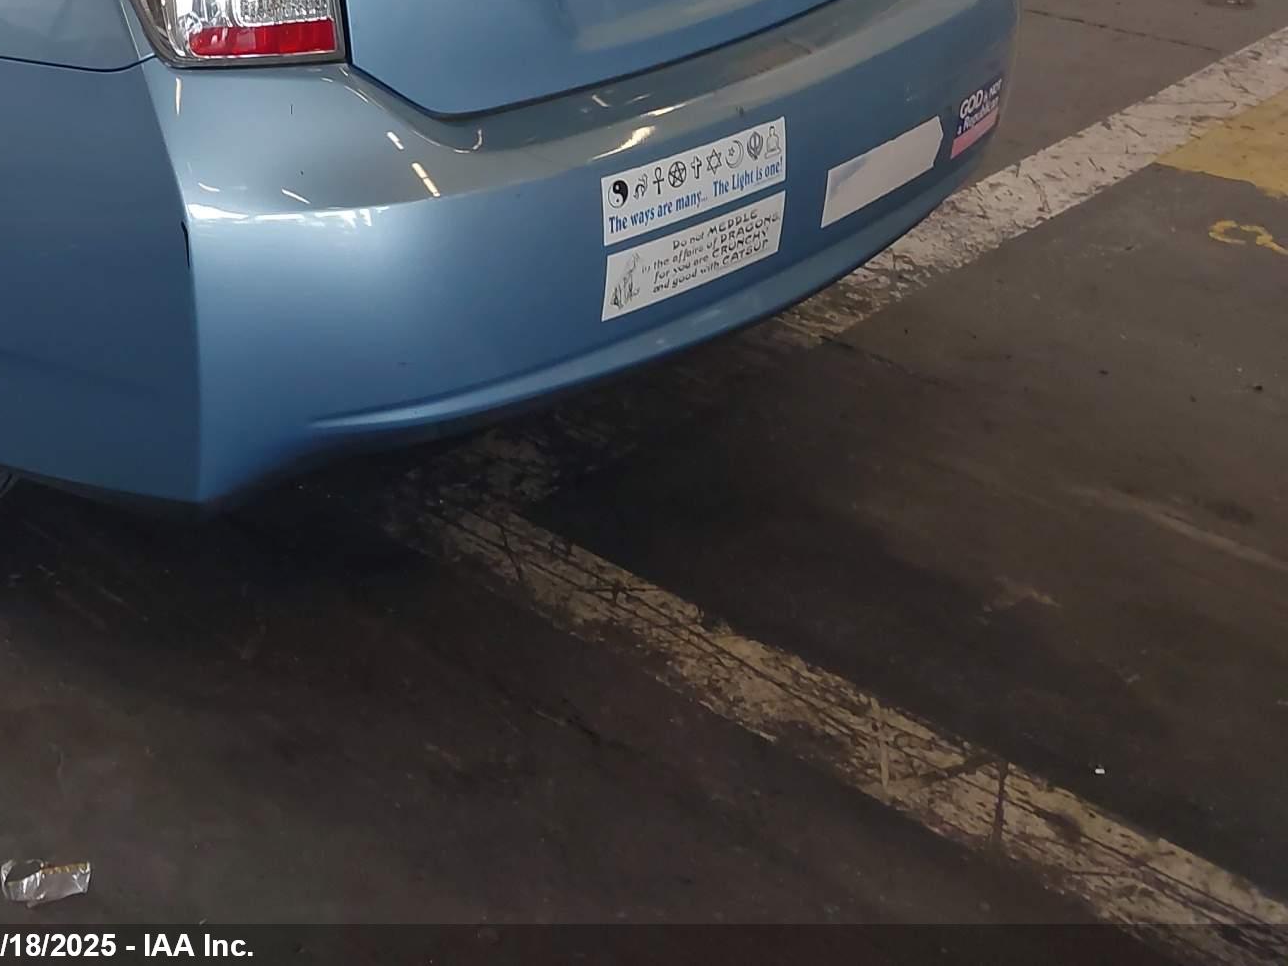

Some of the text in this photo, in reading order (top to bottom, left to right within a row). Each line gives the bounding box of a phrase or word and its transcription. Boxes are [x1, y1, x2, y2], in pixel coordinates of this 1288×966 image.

[960, 90, 984, 119] GOD
[712, 157, 784, 198] The Light is one!
[609, 215, 628, 234] The
[630, 207, 655, 227] ways
[656, 201, 673, 216] are
[672, 208, 759, 251] Do not MEDDLE
[652, 227, 770, 284] for you are CRUNCHY
[653, 254, 670, 270] the
[672, 245, 705, 264] affairs
[706, 237, 718, 251] of
[652, 282, 670, 294] and
[672, 271, 698, 289] good
[700, 262, 720, 276] with
